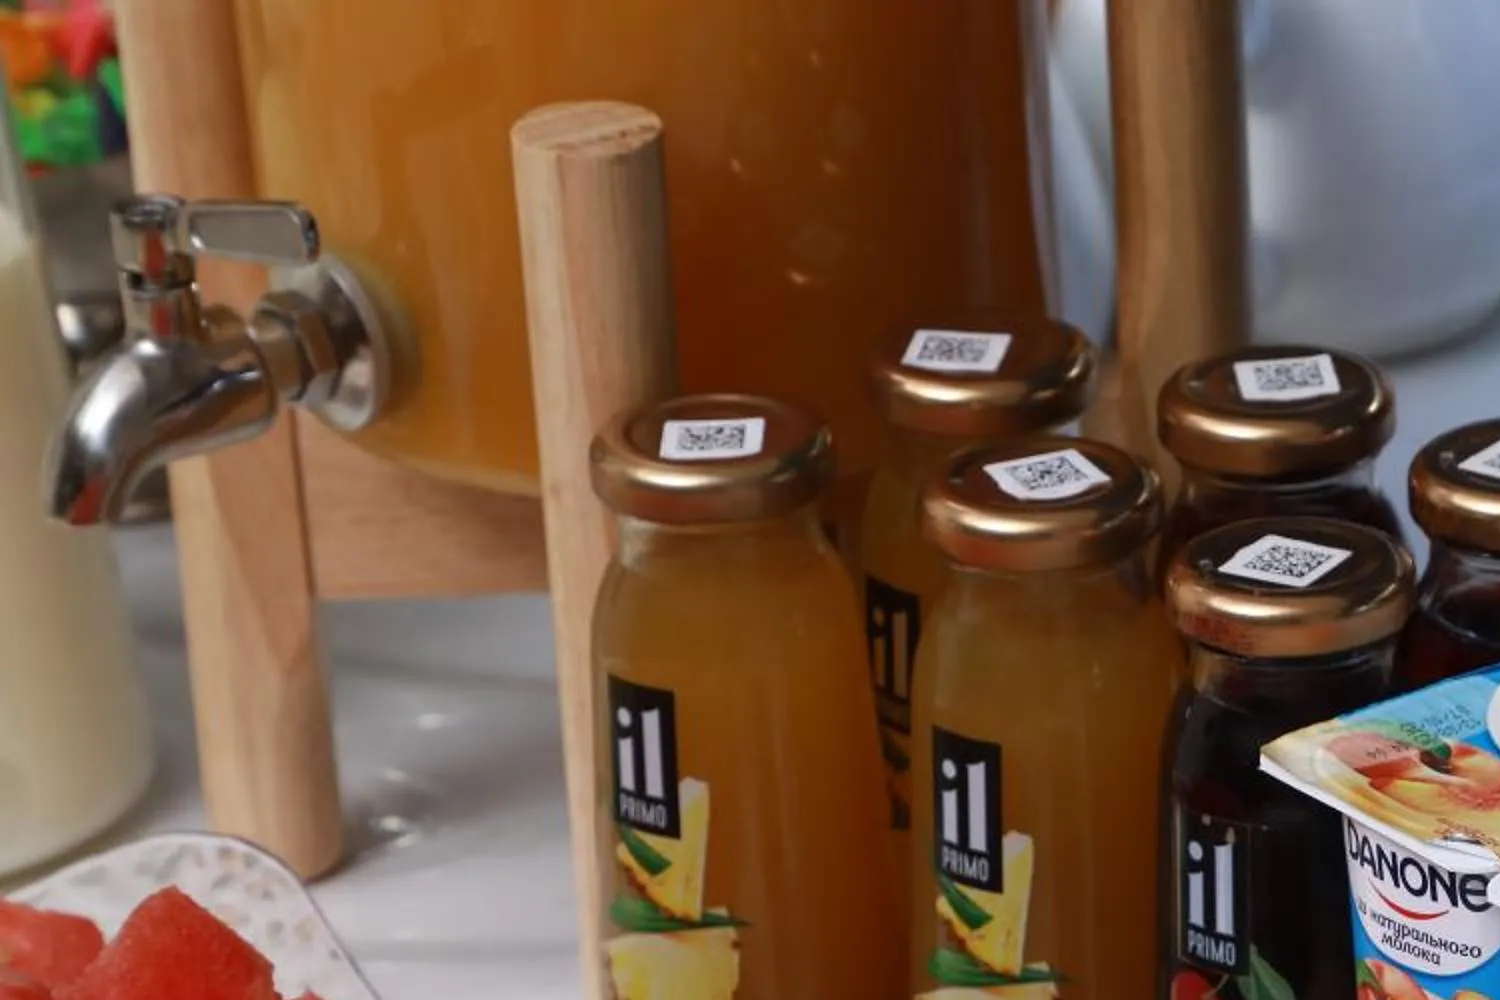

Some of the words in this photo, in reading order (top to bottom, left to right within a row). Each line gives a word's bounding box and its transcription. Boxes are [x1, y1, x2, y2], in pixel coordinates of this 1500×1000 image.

[620, 794, 667, 829] PRIMO
[941, 846, 989, 882] PRIMO
[1348, 822, 1492, 913] DANONE
[1187, 929, 1236, 966] PRIMO
[1381, 933, 1441, 966] молока
